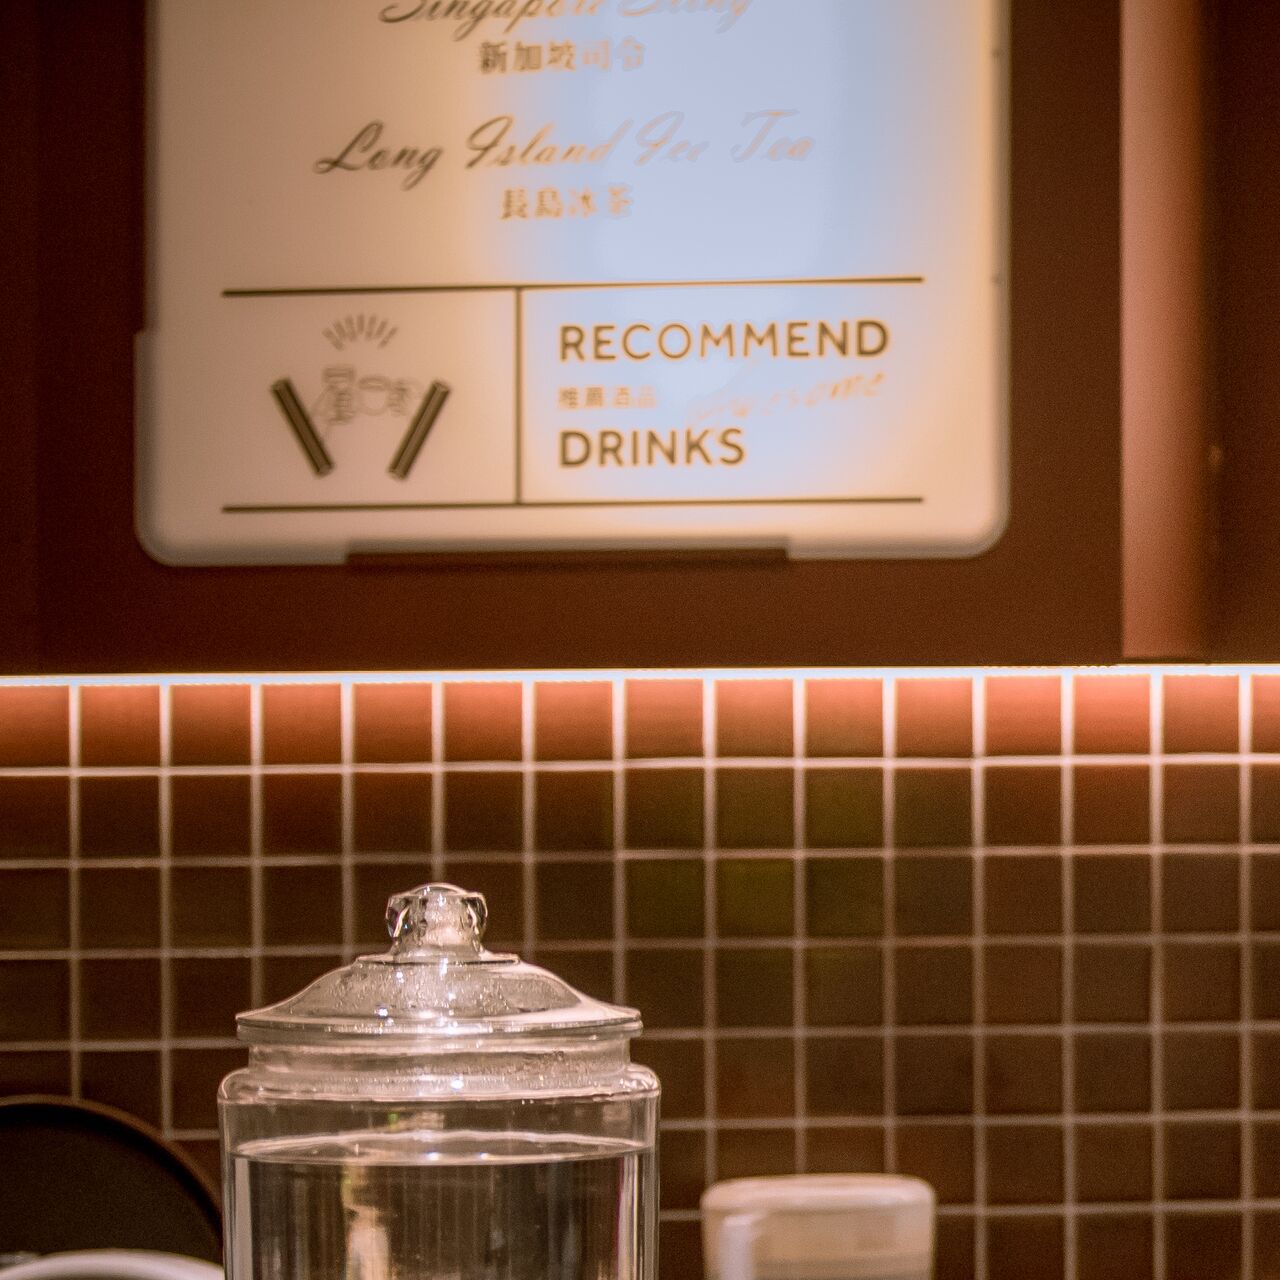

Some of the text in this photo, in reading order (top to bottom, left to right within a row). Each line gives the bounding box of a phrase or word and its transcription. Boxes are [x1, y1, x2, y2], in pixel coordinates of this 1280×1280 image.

[312, 107, 818, 192] Long Island Ice Tea
[559, 319, 890, 363] RECOMMEND
[559, 427, 747, 469] DRINKS
